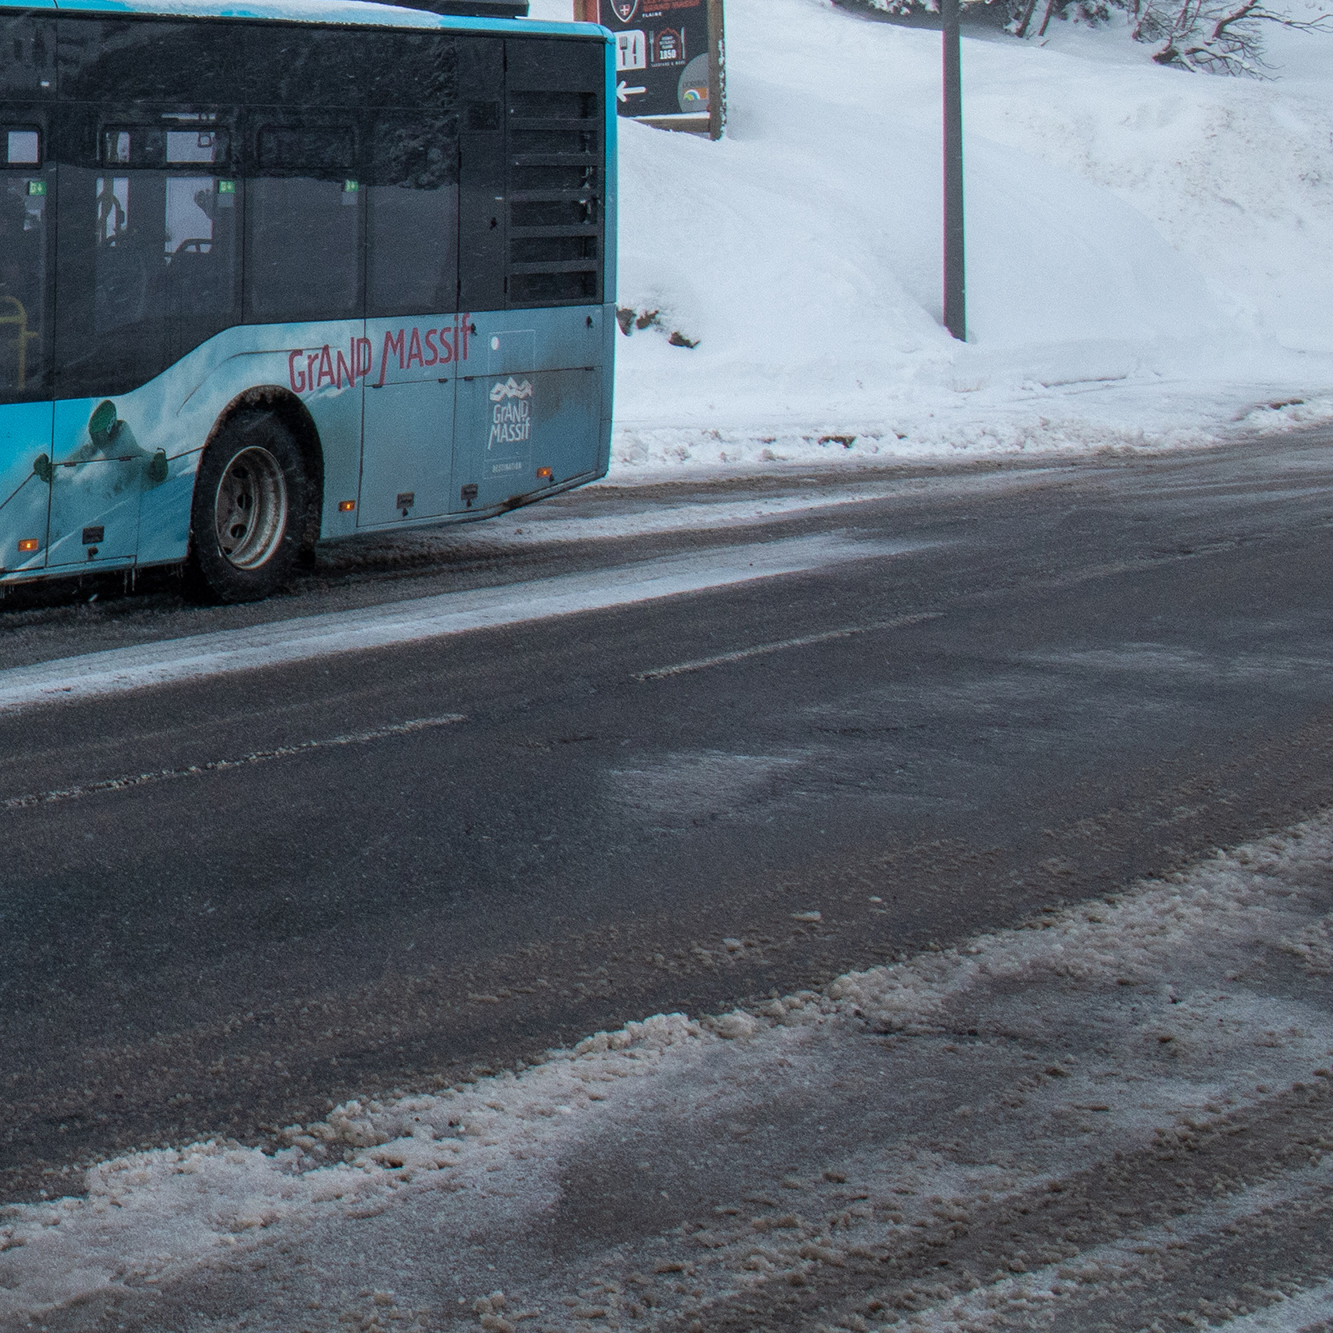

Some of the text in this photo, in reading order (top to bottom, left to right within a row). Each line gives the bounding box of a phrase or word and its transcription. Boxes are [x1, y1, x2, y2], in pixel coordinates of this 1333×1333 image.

[643, 0, 700, 12] GRAND MASSIF
[660, 49, 676, 60] 1850
